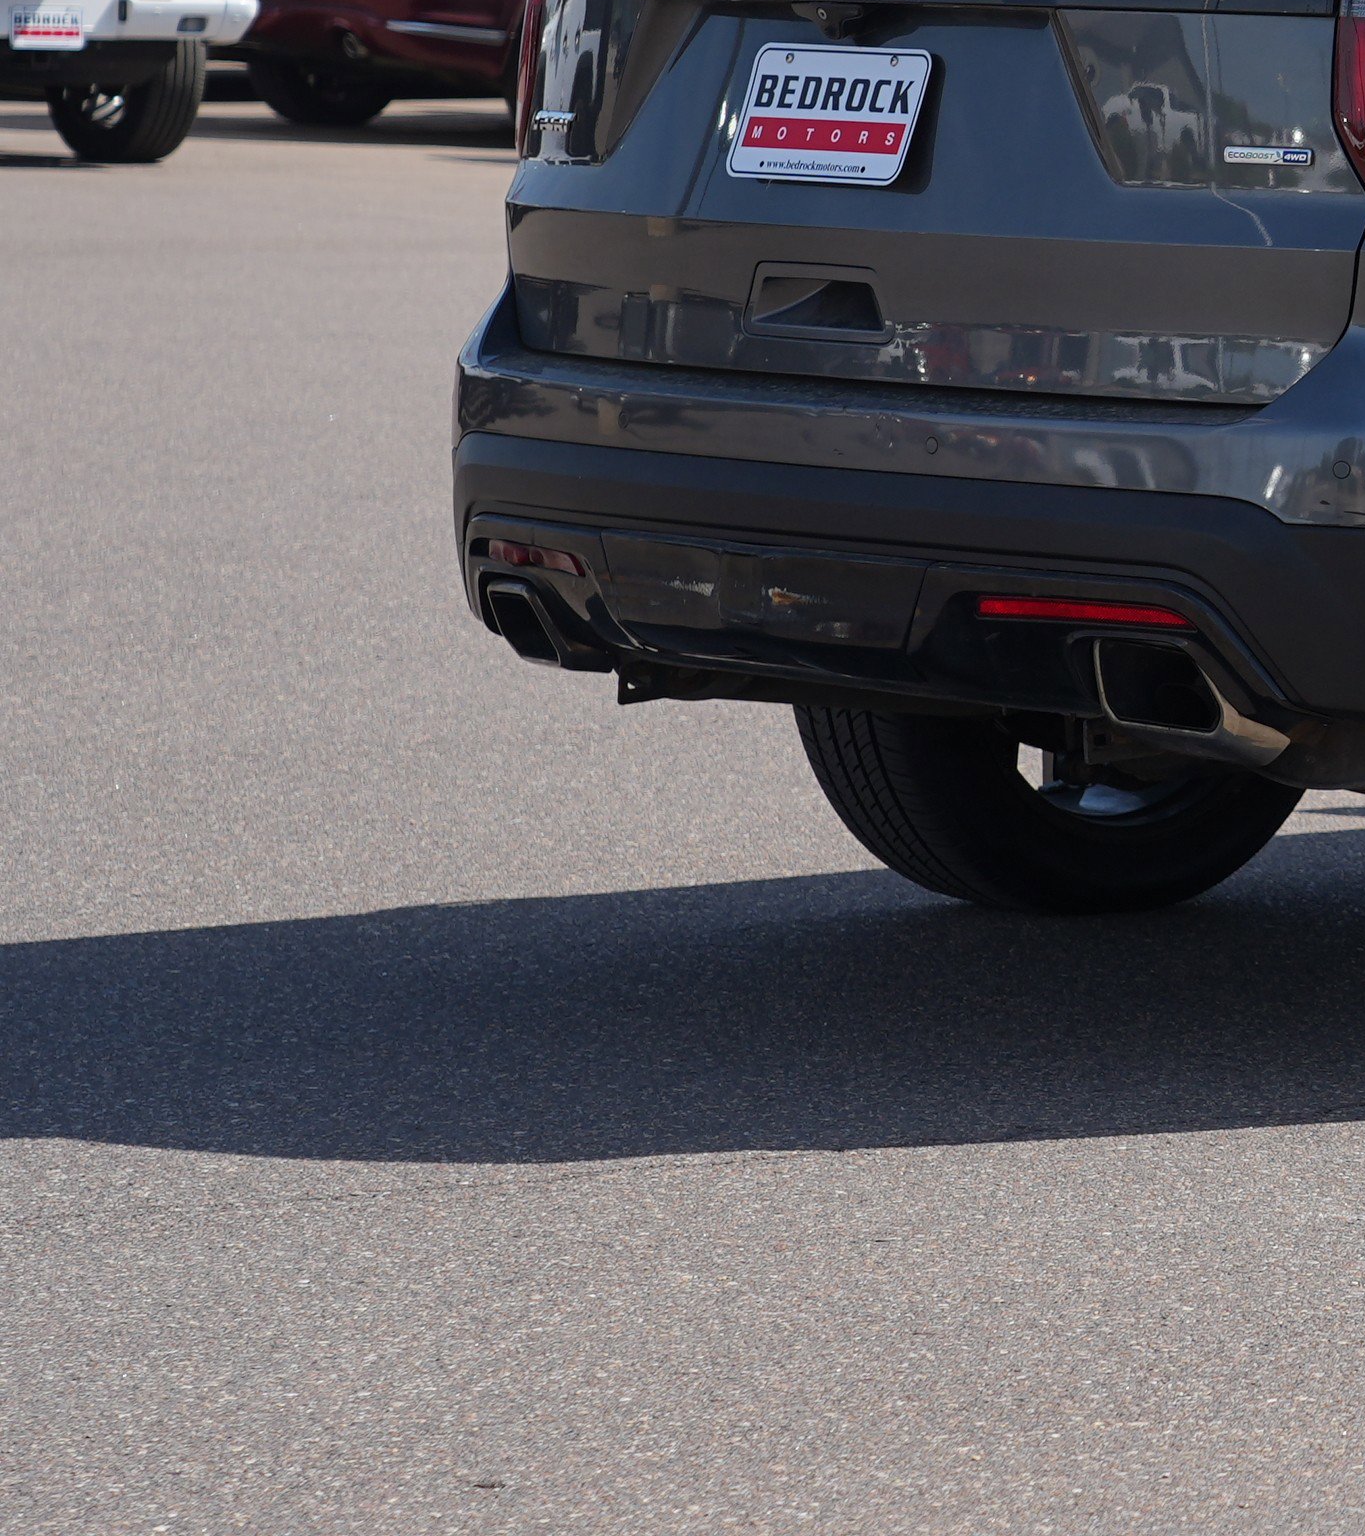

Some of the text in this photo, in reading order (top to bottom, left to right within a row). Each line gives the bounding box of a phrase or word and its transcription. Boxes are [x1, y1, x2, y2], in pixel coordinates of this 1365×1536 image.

[754, 75, 915, 114] BEDROCK
[752, 125, 896, 146] MOTORS
[766, 159, 860, 174] www.bedrockmotors.com
[1283, 154, 1307, 162] 4WD
